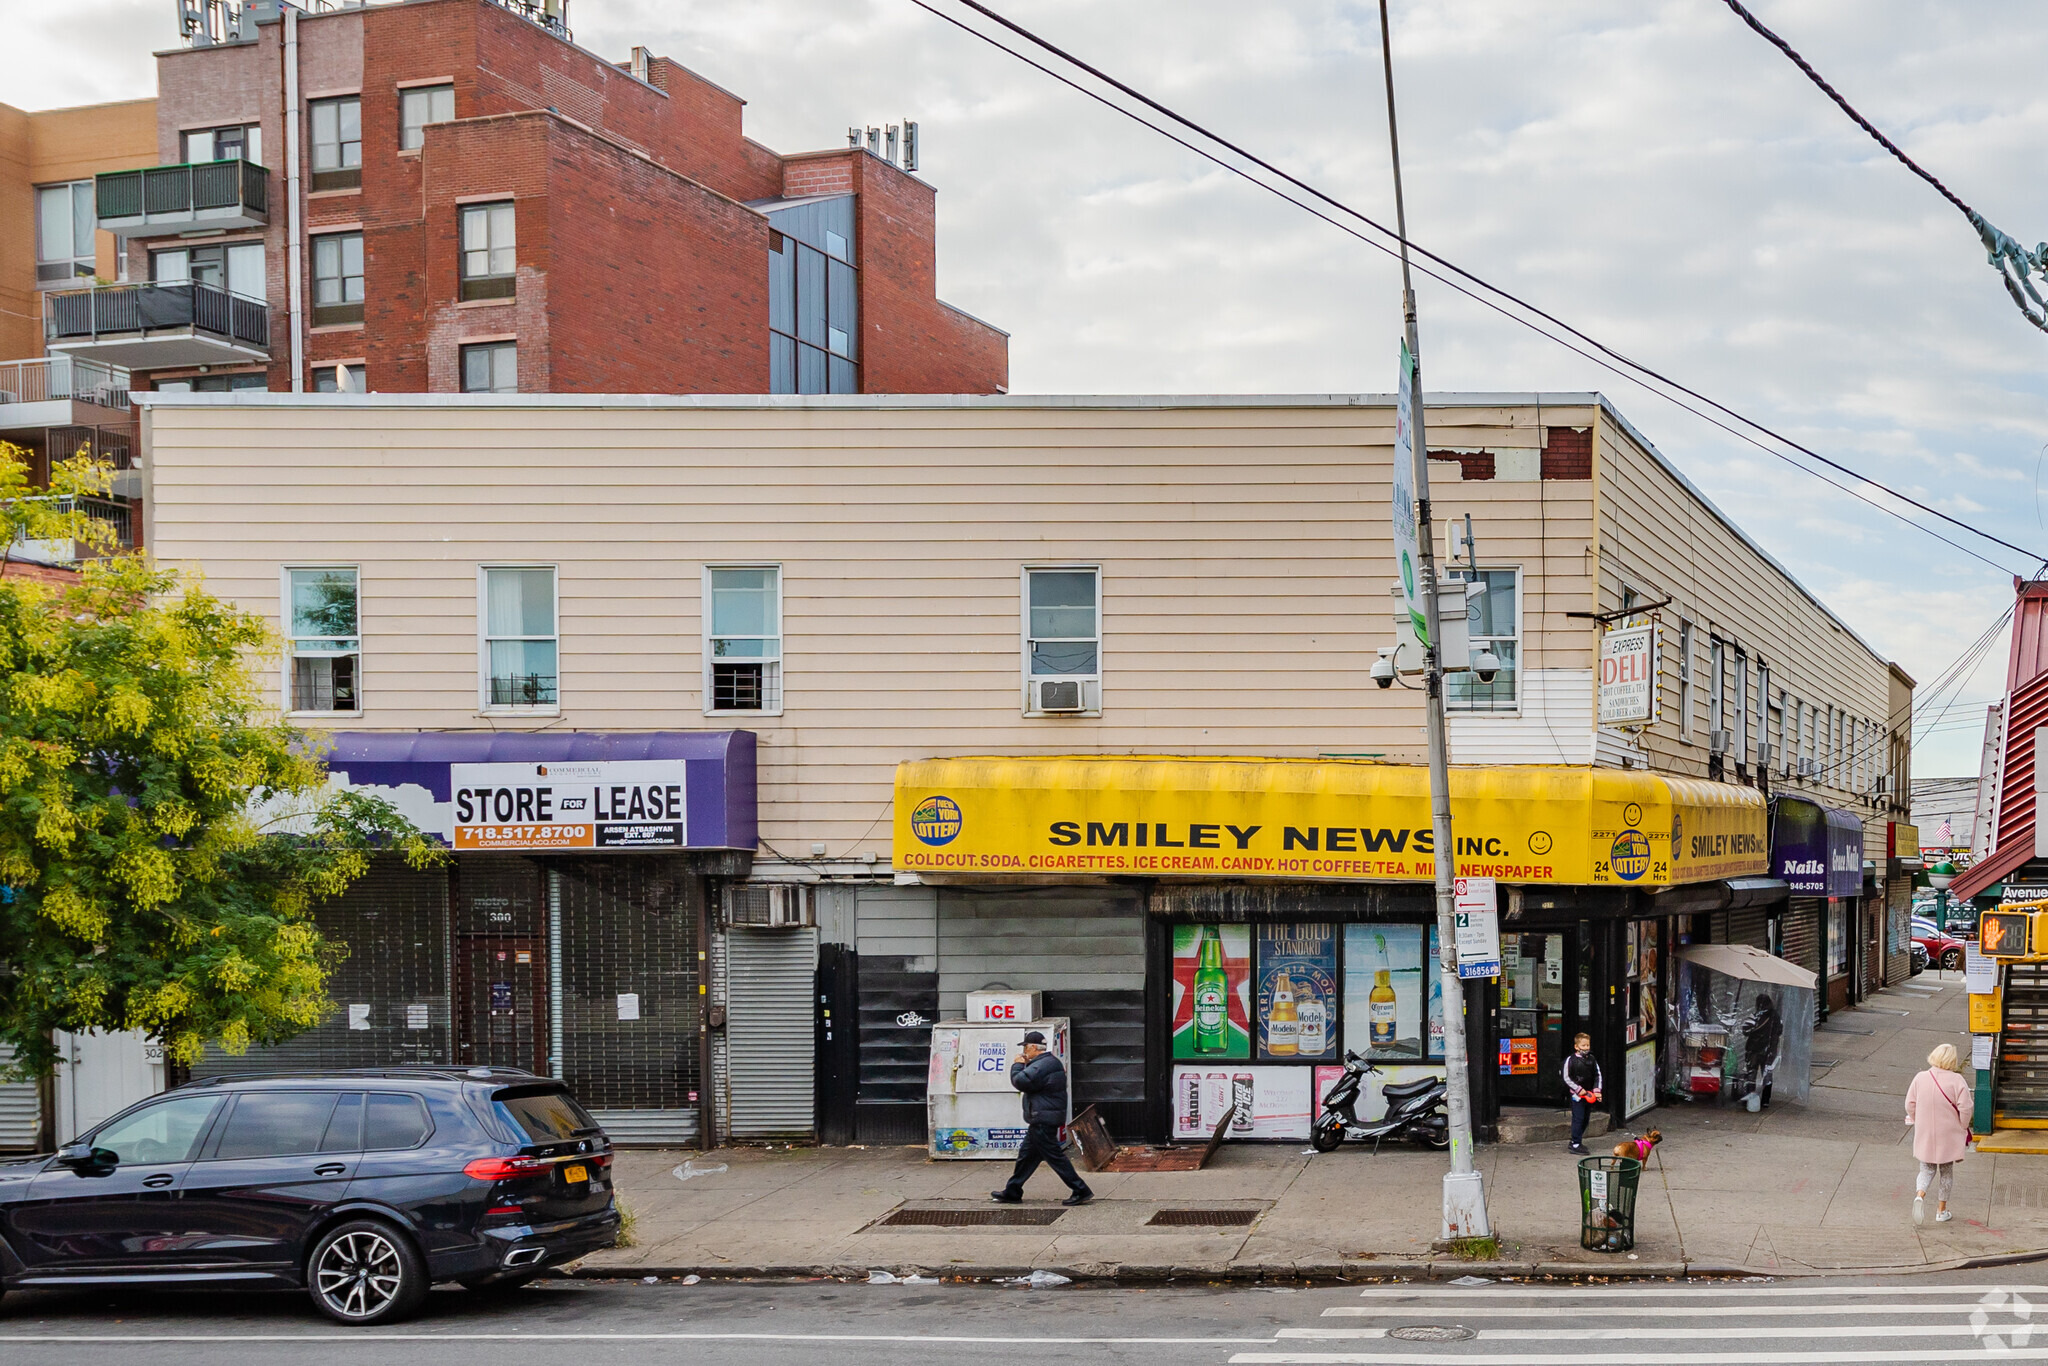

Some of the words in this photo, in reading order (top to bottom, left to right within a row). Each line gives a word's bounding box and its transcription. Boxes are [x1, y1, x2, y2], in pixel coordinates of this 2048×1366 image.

[1612, 636, 1645, 654] EXPRESS
[1602, 652, 1647, 686] DELI
[456, 787, 553, 823] STORE
[563, 800, 584, 809] FOR
[594, 785, 681, 820] LEASE
[937, 799, 955, 810] NEW
[938, 809, 960, 822] YORK
[463, 826, 586, 839] 718.517.8700
[912, 822, 960, 839] LOTTERY
[478, 839, 570, 847] COMMERCIALACQ.COM
[1048, 821, 1262, 849] SMILEY
[1282, 826, 1434, 854] NEWS
[1457, 837, 1509, 857] INC.
[1631, 833, 1645, 843] NEW
[1632, 842, 1649, 856] YORK
[1691, 834, 1729, 859] SMILEY
[1730, 833, 1755, 854] NEWS
[903, 853, 978, 867] COLDCUT.
[980, 854, 1025, 868] SODA.
[1028, 855, 1129, 869] CIGARETTES.
[1133, 856, 1158, 869] ICE
[1160, 856, 1219, 870] CREAM.
[1222, 857, 1275, 871] CANDY.
[1277, 858, 1309, 872] HOT
[1312, 859, 1410, 875] COFFEE/TEA.
[1460, 864, 1553, 879] NEWSPAPER
[1594, 861, 1609, 872] 24
[1612, 856, 1650, 874] LOTTERY
[1653, 861, 1667, 873] 24
[1783, 860, 1825, 875] Nails
[1594, 873, 1609, 882] Hrs
[1653, 873, 1667, 881] Hrs
[1789, 882, 1824, 890] 946-5705
[2002, 886, 2048, 899] Avenue
[1458, 913, 1467, 927] 2
[1267, 924, 1292, 941] THE
[1295, 924, 1330, 941] GOLD
[1274, 941, 1321, 956] STANDARD
[984, 1005, 1015, 1019] ICE
[144, 1049, 163, 1060] 302
[979, 1047, 1006, 1056] THOMAS
[1520, 1052, 1536, 1065] 65
[977, 1057, 1005, 1072] ICE
